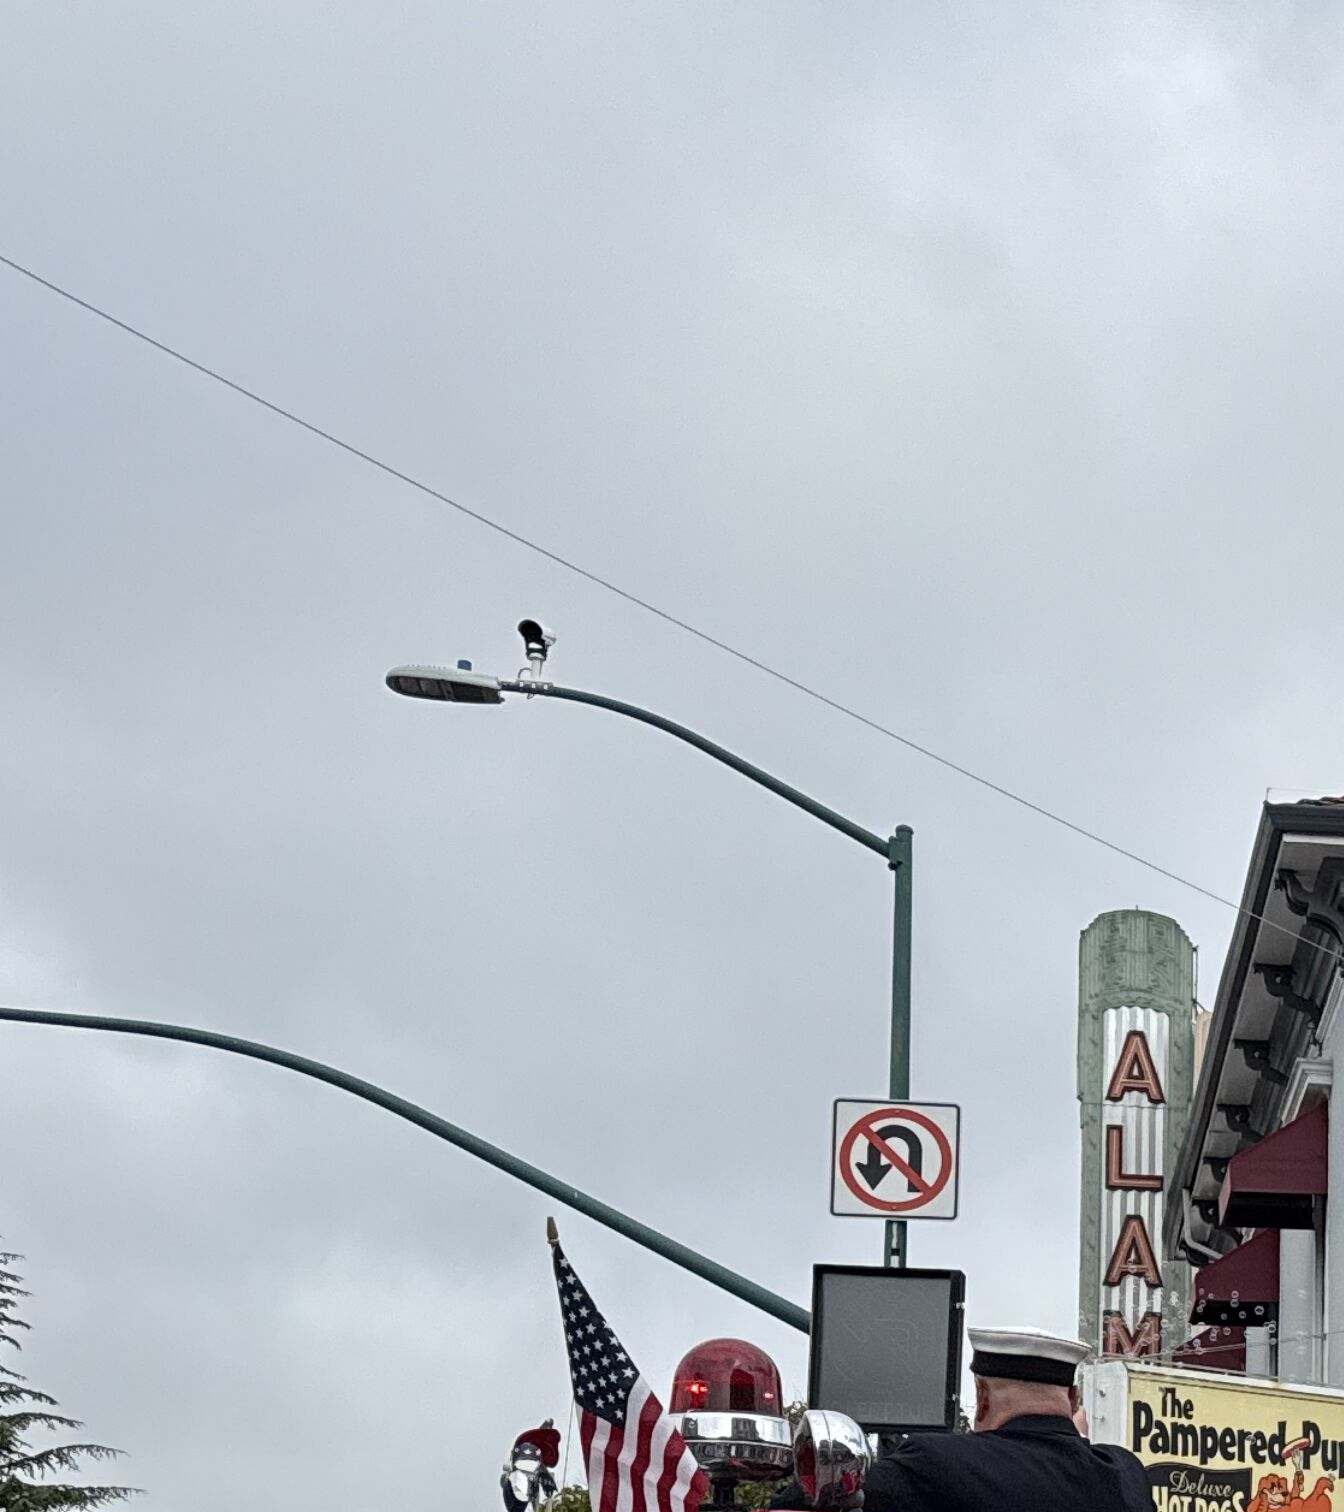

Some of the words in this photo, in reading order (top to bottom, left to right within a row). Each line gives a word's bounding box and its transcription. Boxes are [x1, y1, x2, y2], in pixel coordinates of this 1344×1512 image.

[1159, 1387, 1194, 1420] The
[1133, 1400, 1287, 1466] Pampered
[1170, 1471, 1234, 1497] Deluxe
